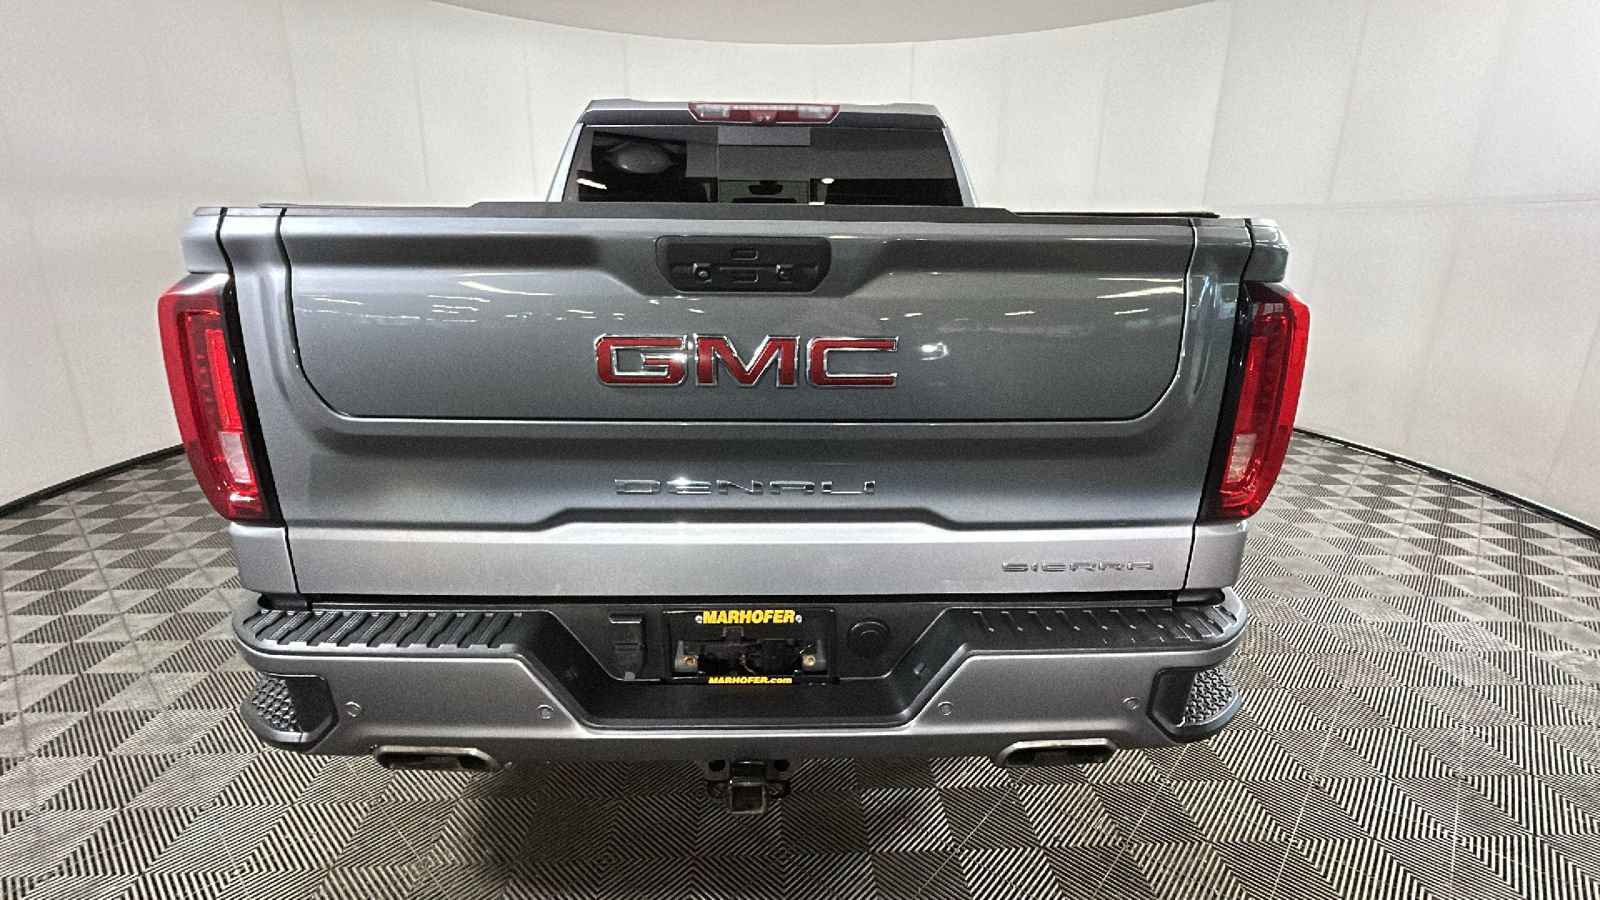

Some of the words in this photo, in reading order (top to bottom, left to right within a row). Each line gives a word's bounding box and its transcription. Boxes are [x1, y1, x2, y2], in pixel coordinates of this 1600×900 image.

[594, 333, 899, 387] GMC
[614, 479, 876, 495] DENALI
[1001, 561, 1154, 572] SIERRA
[702, 609, 796, 624] MARHOFER
[708, 676, 793, 684] MARHOFER.com
